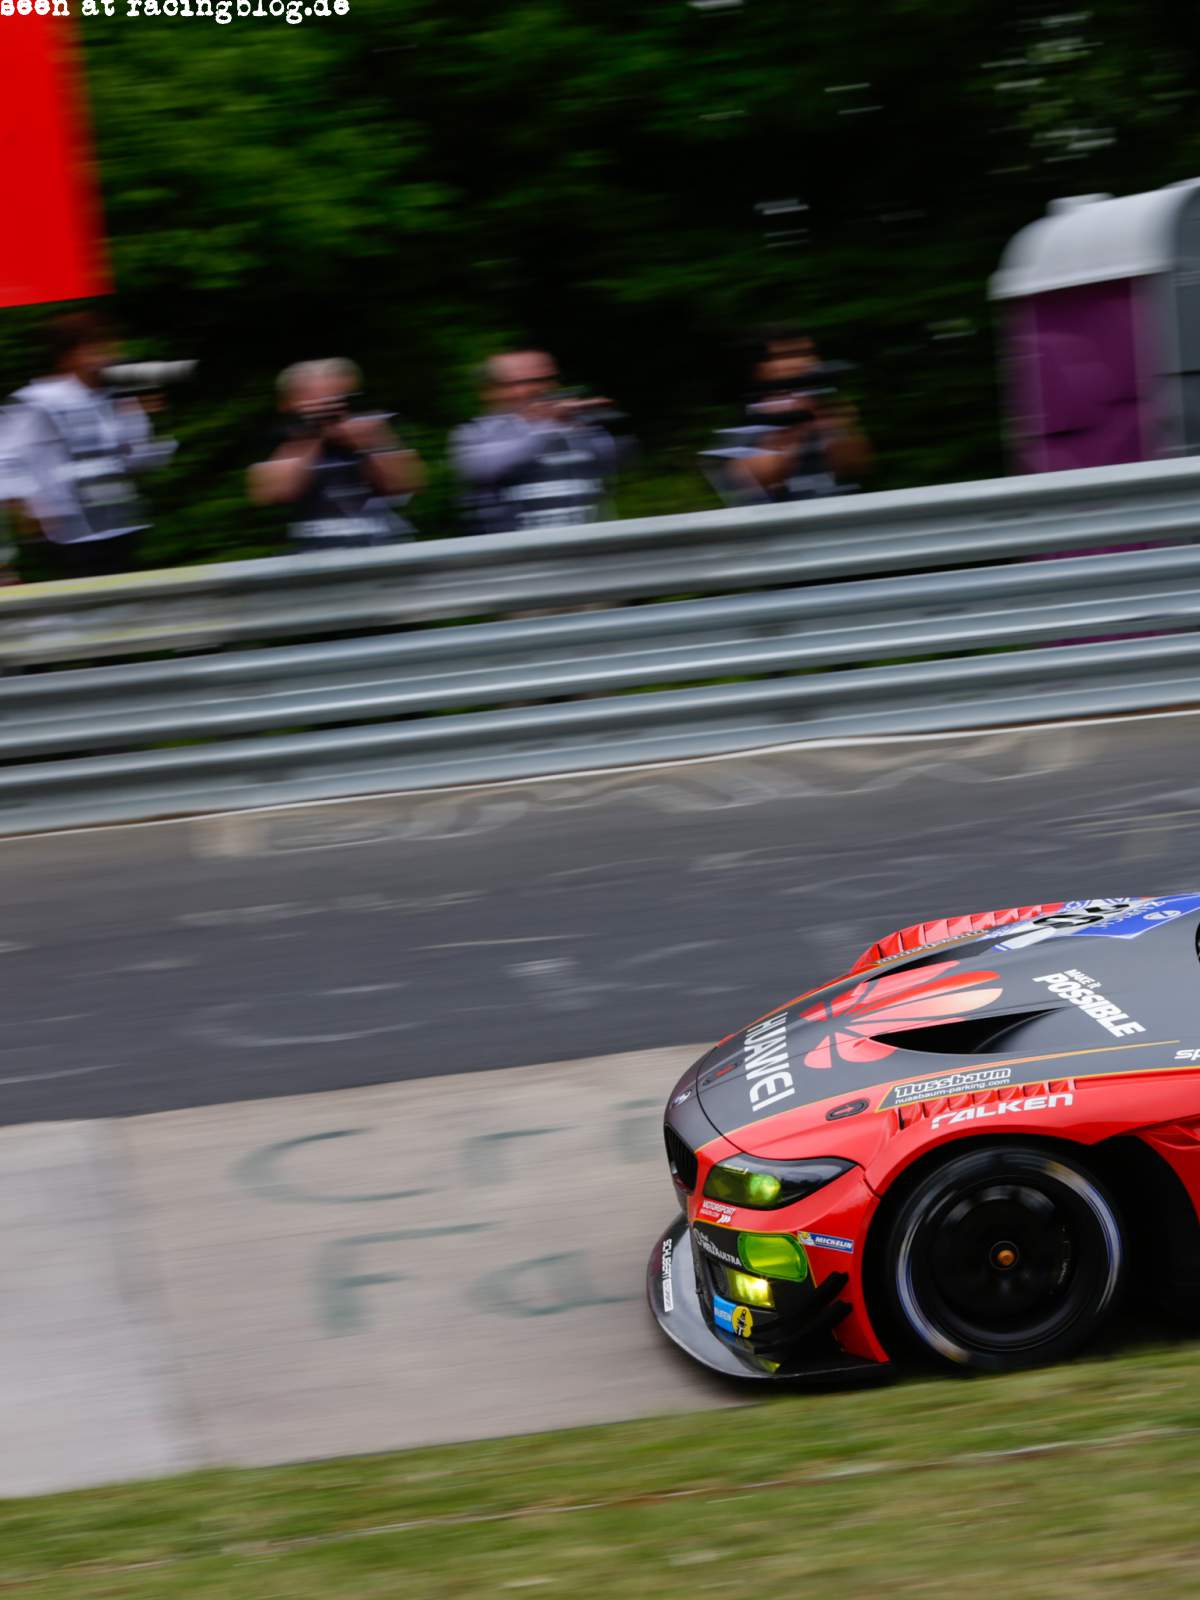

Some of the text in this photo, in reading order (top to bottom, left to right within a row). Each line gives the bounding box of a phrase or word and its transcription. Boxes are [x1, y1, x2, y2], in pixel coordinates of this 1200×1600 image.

[1031, 972, 1147, 1038] POSSIBLE
[743, 1011, 796, 1112] HUAWEI
[894, 1079, 1011, 1105] nussbaum-parking.com
[931, 1093, 1073, 1130] FALKEN
[815, 1236, 853, 1249] MICHELIN
